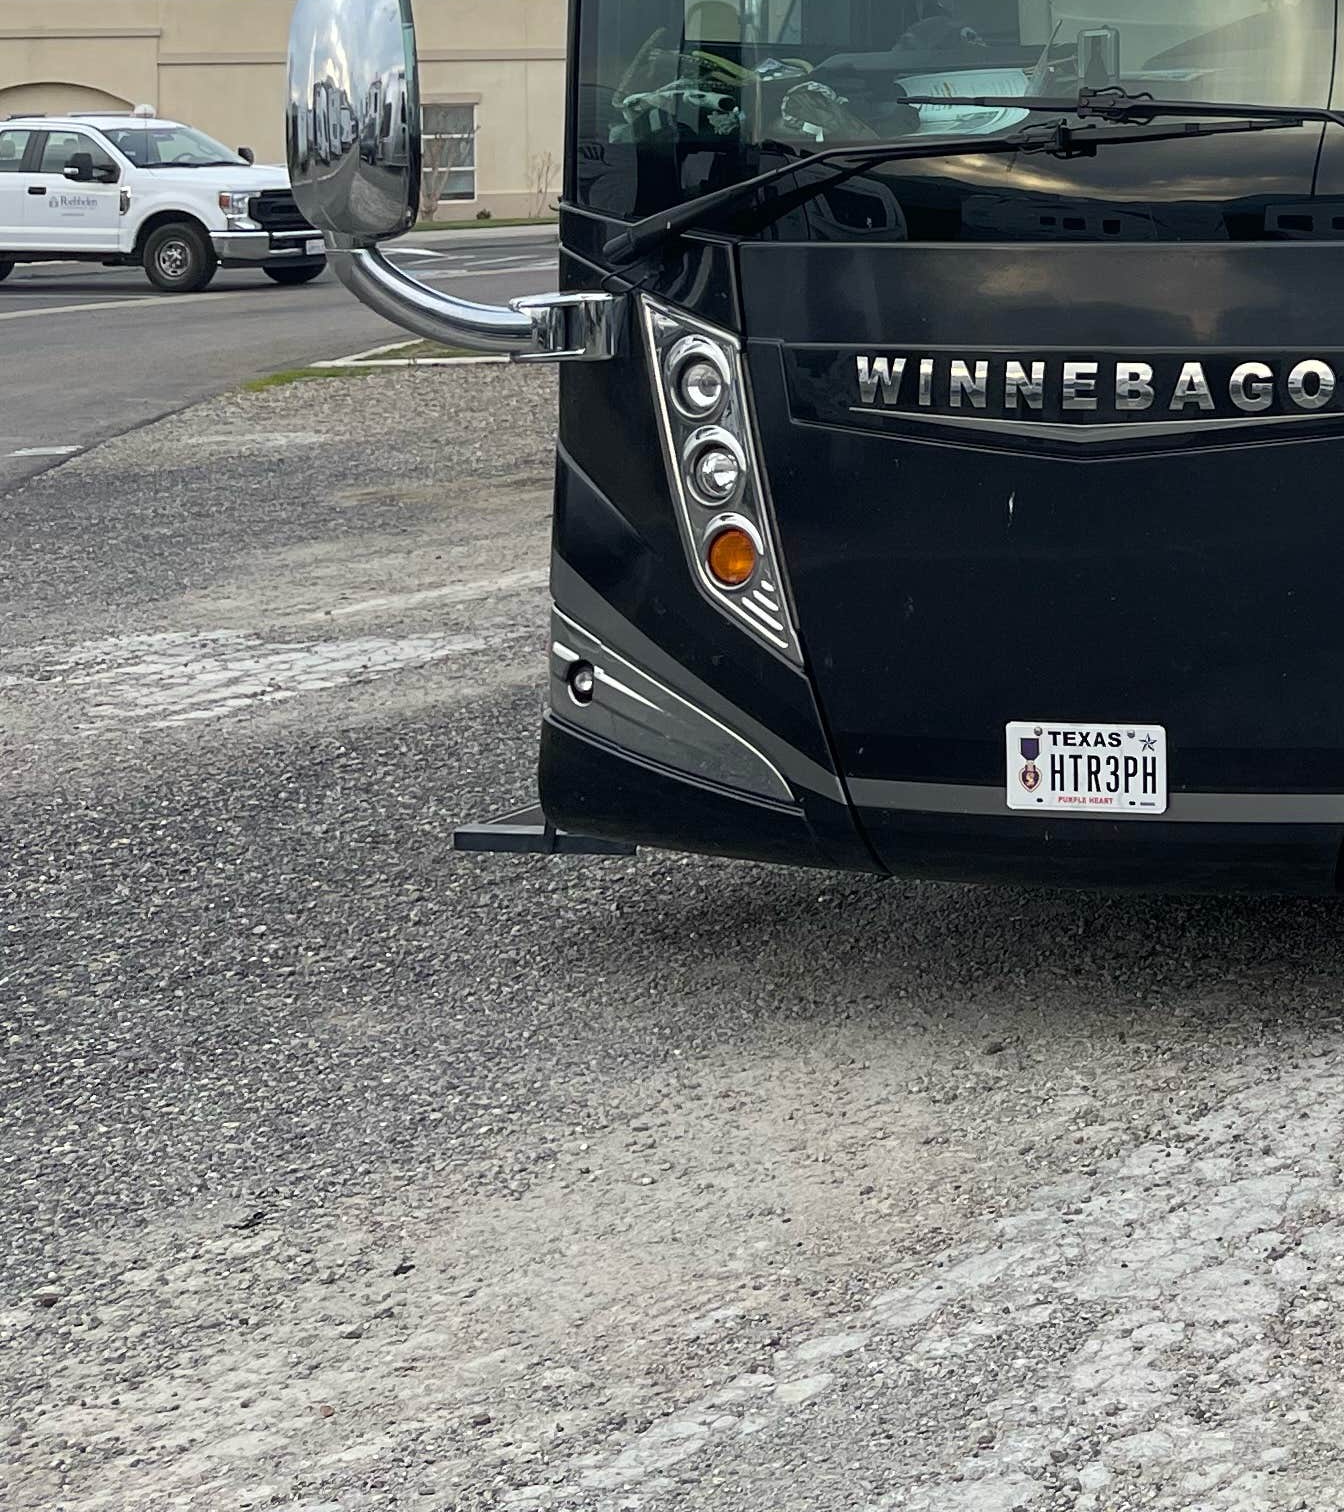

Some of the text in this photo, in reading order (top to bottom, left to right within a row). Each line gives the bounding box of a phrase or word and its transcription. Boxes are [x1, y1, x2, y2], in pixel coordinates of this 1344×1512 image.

[855, 355, 1337, 412] WINNEBAGO
[1048, 731, 1122, 748] TEXAS
[1050, 753, 1157, 794] HTR3PH
[1058, 796, 1114, 805] PURPLE HEART
